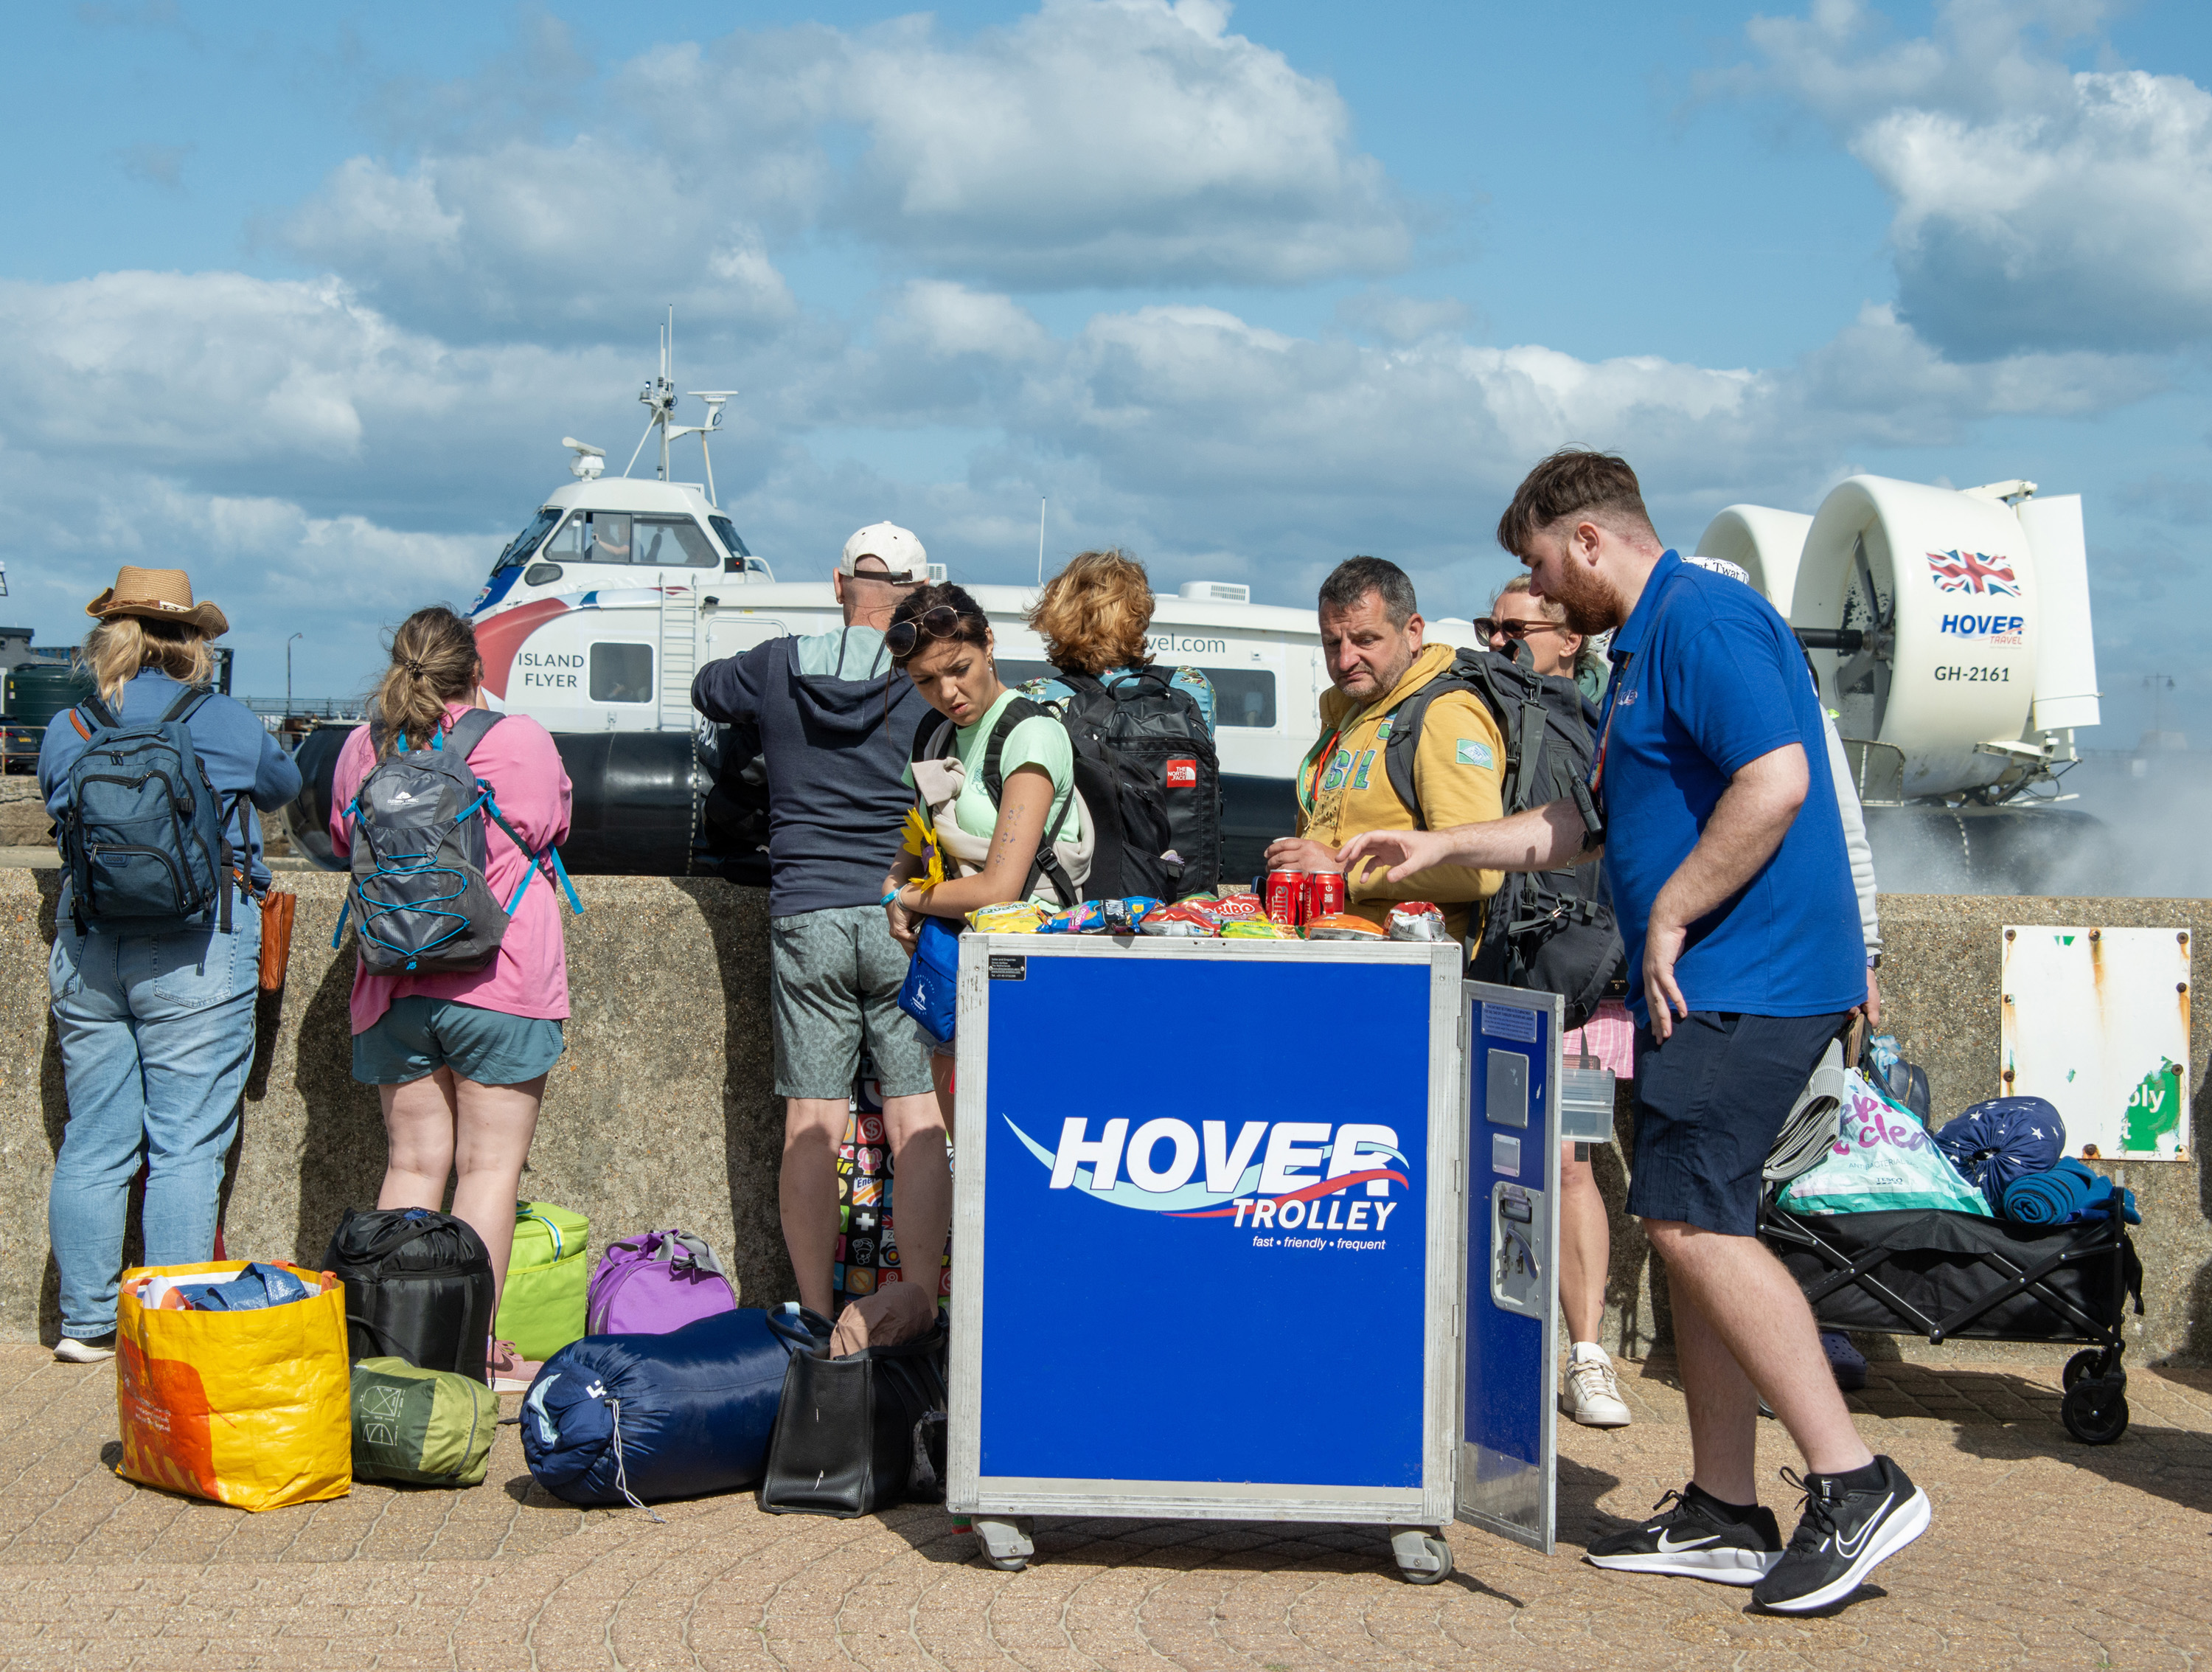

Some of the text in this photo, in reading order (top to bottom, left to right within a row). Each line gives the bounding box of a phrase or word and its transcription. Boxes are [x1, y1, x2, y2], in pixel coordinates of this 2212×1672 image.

[1941, 614, 2025, 635] HOVER
[1990, 636, 2022, 645] TRAVEL
[519, 653, 584, 667] ISLAND
[525, 673, 577, 687] FLYER
[1934, 666, 2009, 681] GH-2161
[1271, 886, 1288, 924] Billie
[1049, 1117, 1399, 1196] HOVER
[1848, 1159, 1905, 1170] ANTIBACTERIAL
[1233, 1199, 1397, 1231] TROLLEY
[1253, 1235, 1386, 1250] fast friendly frequent
